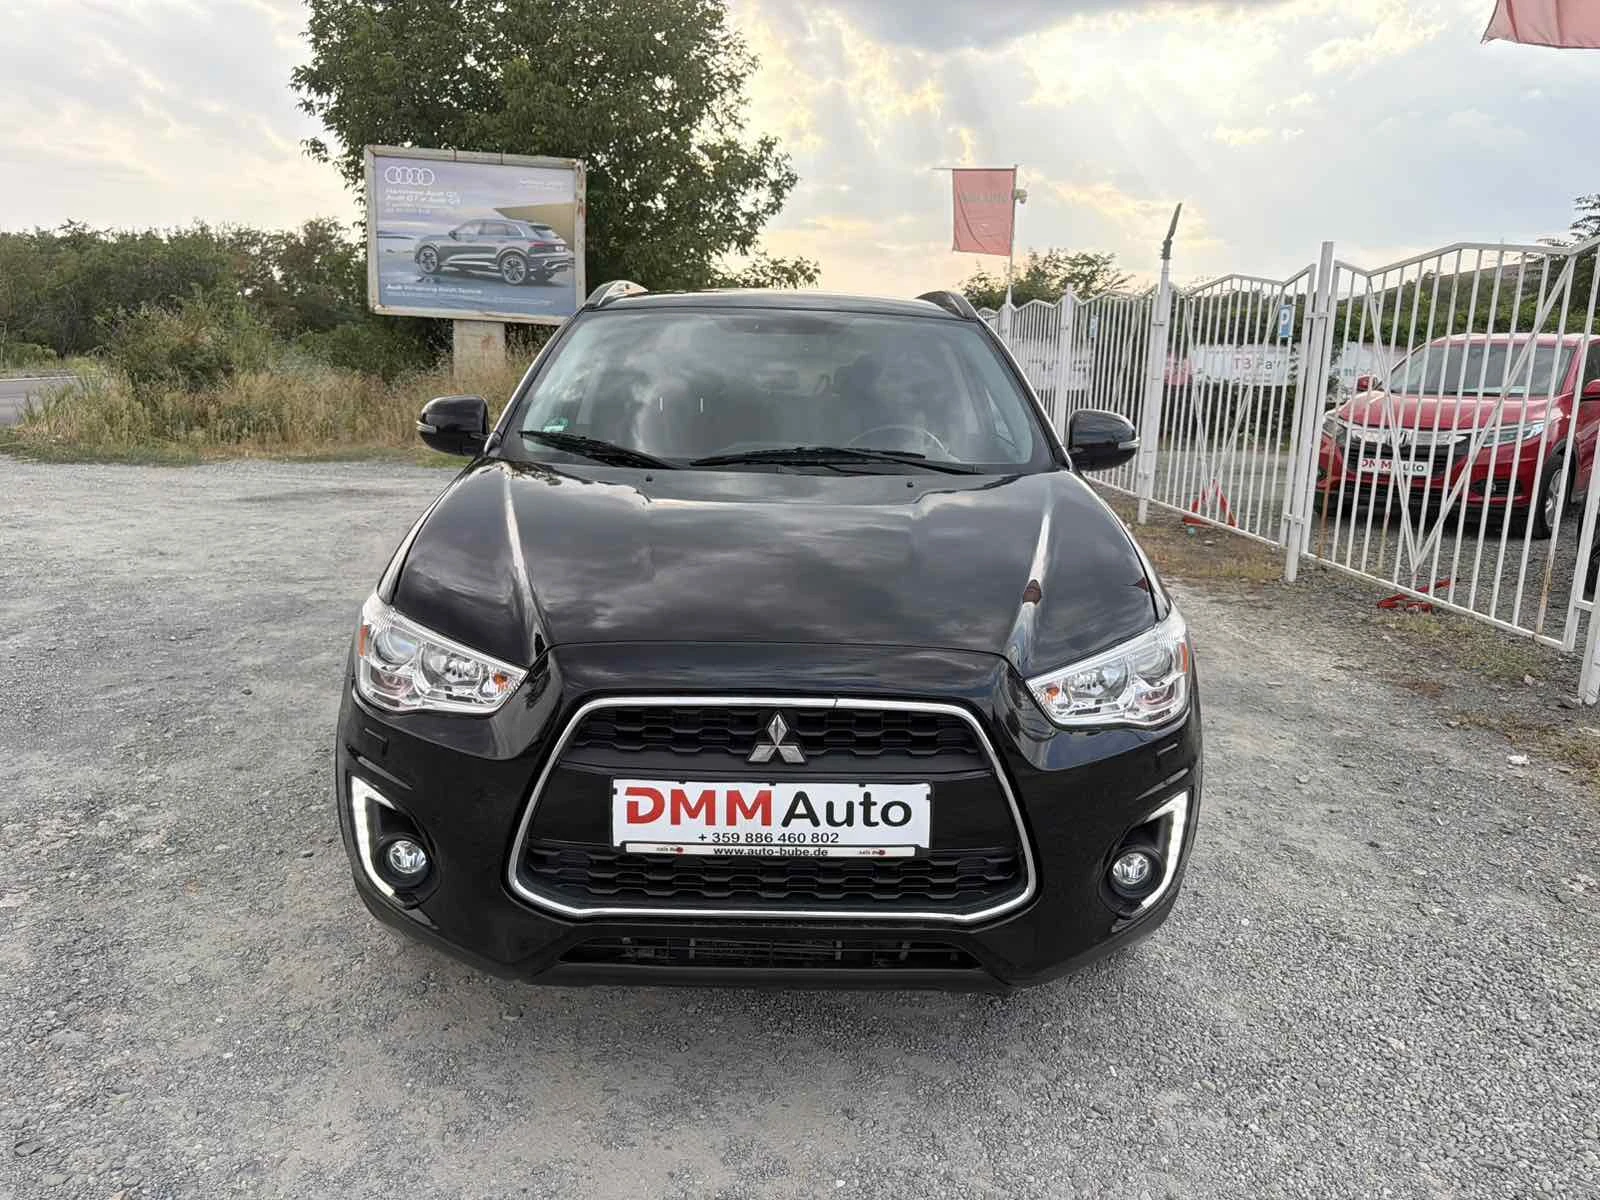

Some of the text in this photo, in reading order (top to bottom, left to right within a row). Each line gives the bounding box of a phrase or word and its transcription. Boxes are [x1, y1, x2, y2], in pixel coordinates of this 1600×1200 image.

[625, 786, 912, 828] DMM Auto
[698, 832, 839, 843] + 359 886 460 802
